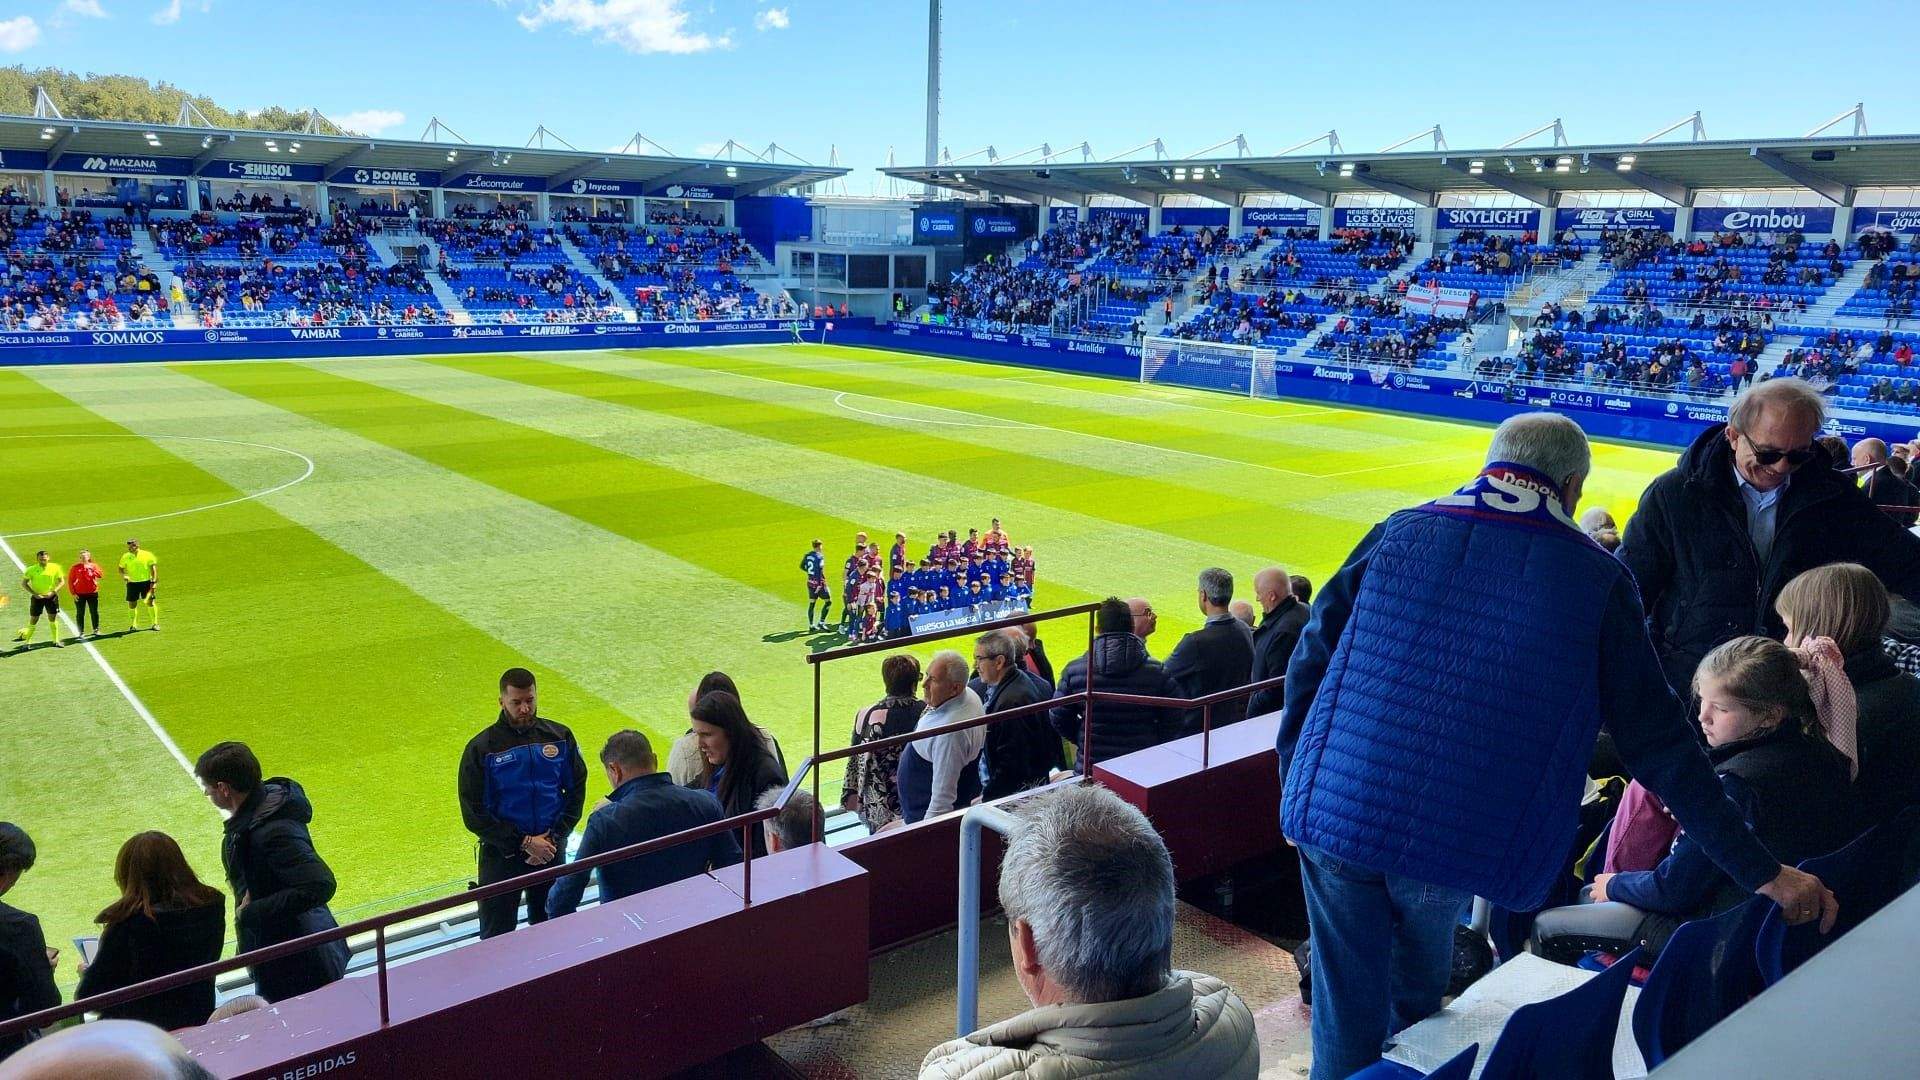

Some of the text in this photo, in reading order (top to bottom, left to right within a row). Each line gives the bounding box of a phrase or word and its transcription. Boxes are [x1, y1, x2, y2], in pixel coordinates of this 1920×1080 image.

[109, 158, 157, 168] MAZANA
[372, 170, 417, 182] DOMEC
[480, 179, 524, 189] ecomputer
[588, 182, 620, 192] Inycom
[1252, 211, 1278, 222] Gopick
[1346, 215, 1414, 223] LOS OLIVOS
[1449, 209, 1533, 224] SKYLIGHT
[1627, 210, 1655, 218] GIRAL
[1723, 208, 1806, 229] embou
[990, 225, 1016, 233] CABRERO
[300, 328, 342, 339] AMBAR
[464, 326, 504, 336] CaixaBank
[664, 323, 700, 333] embou
[92, 331, 164, 345] SOMMOS
[1313, 365, 1354, 381] Alcampo
[1550, 391, 1593, 404] ROGAR
[1688, 411, 1729, 423] CABRERO
[807, 561, 815, 575] 2
[283, 1051, 356, 1080] BEBIDAS
